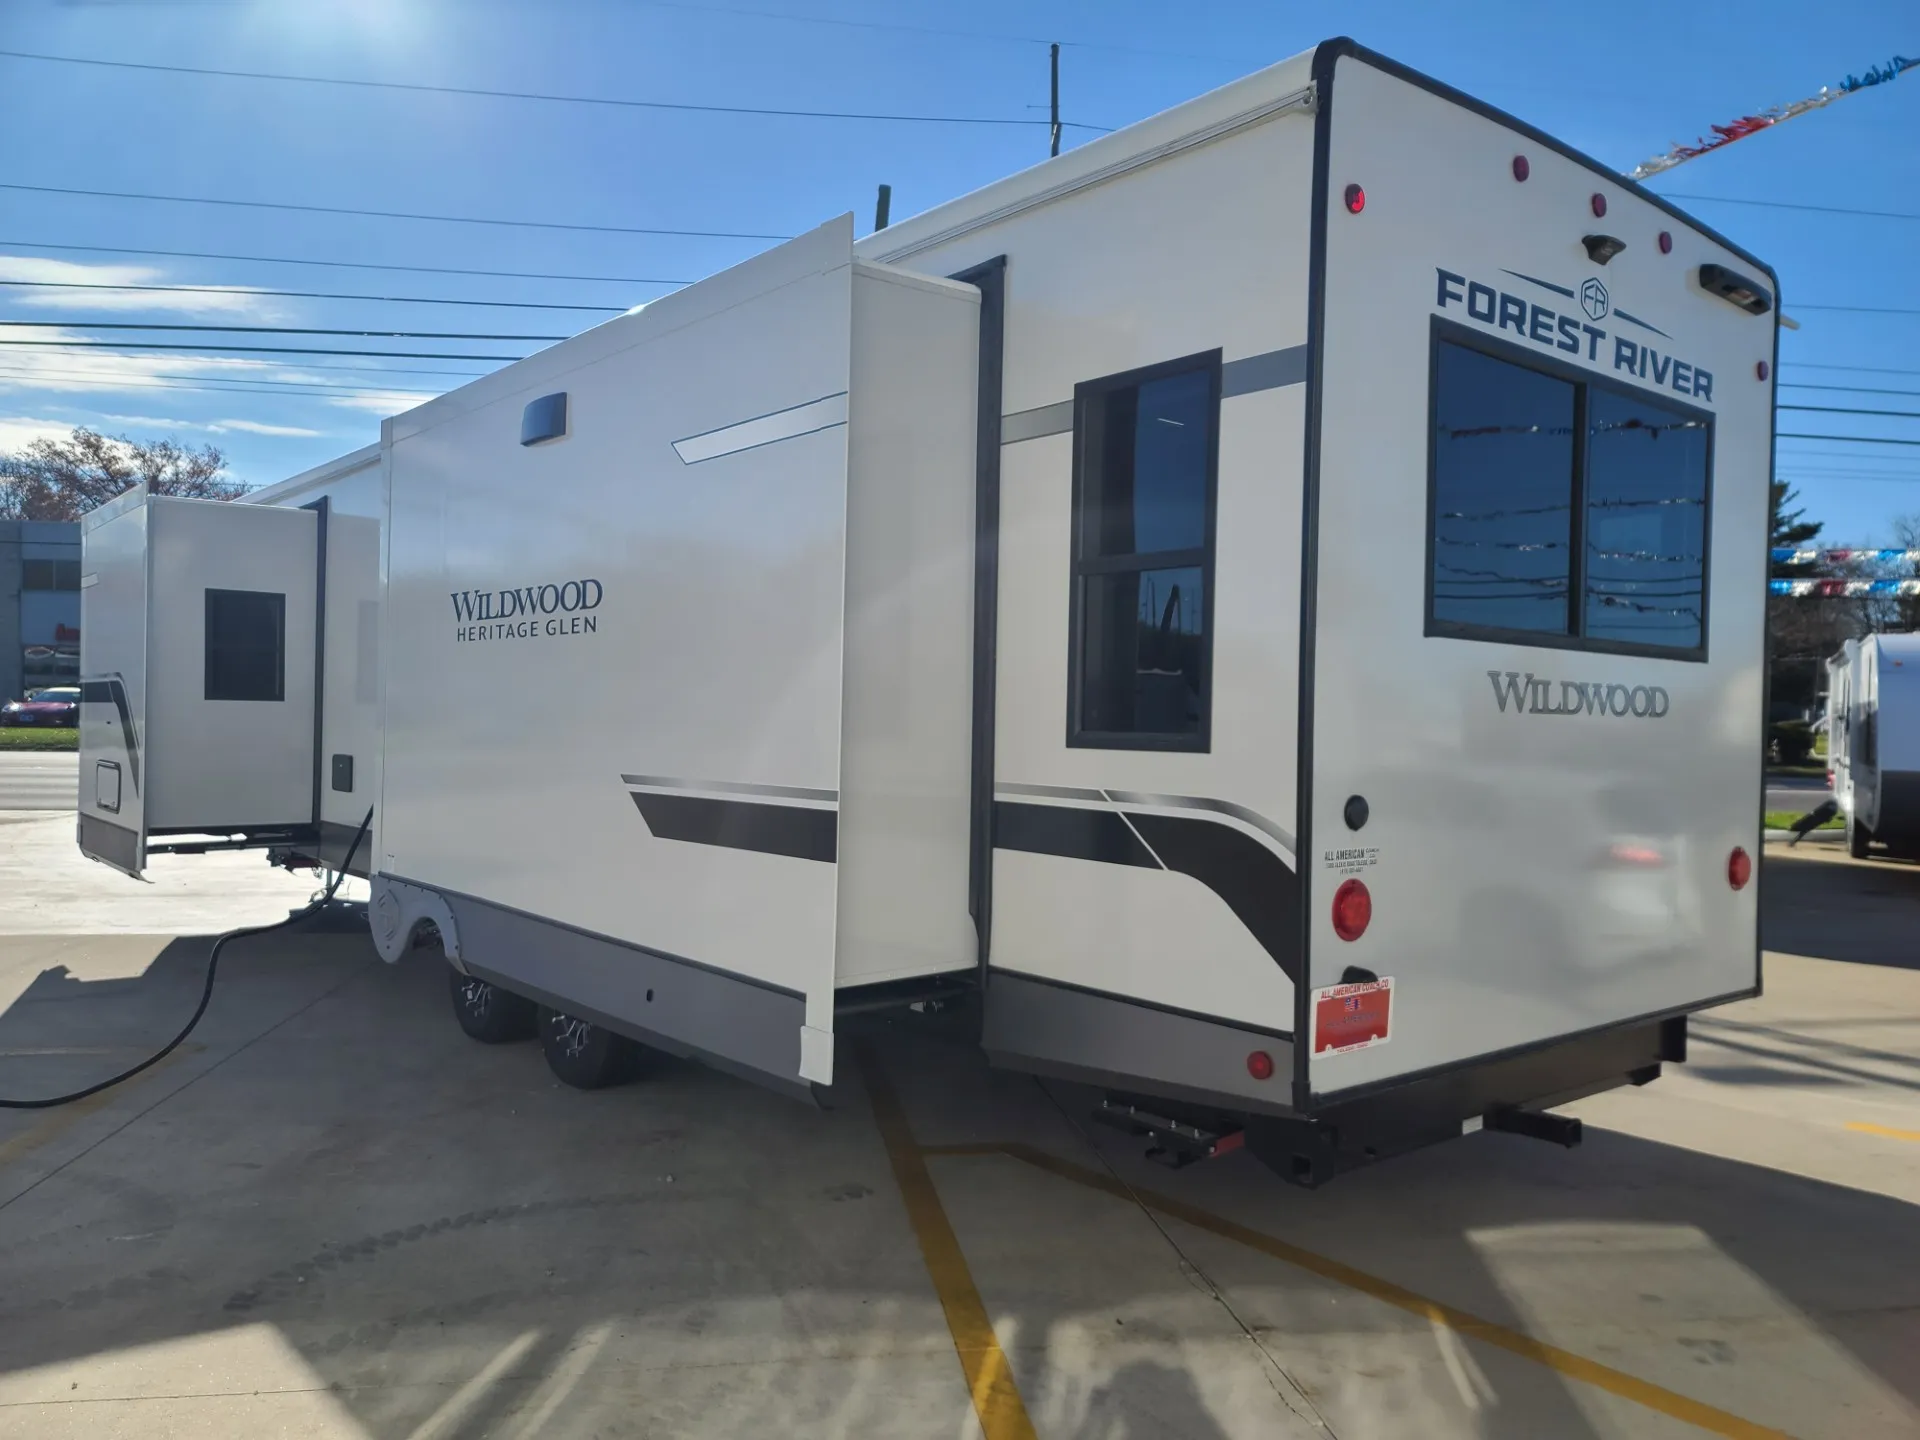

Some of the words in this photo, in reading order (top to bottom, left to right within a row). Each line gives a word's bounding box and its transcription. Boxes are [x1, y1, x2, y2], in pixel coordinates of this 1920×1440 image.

[1435, 267, 1607, 362] FOREST
[1614, 335, 1714, 403] RIVER
[451, 579, 603, 622] WILDWOOD
[457, 621, 539, 642] HERITAGE
[545, 615, 597, 636] GLEN
[1487, 670, 1670, 718] WILDWOOD
[1324, 850, 1334, 861] ALL
[1335, 848, 1365, 860] AMERICAN
[1332, 983, 1361, 997] AMERICAN
